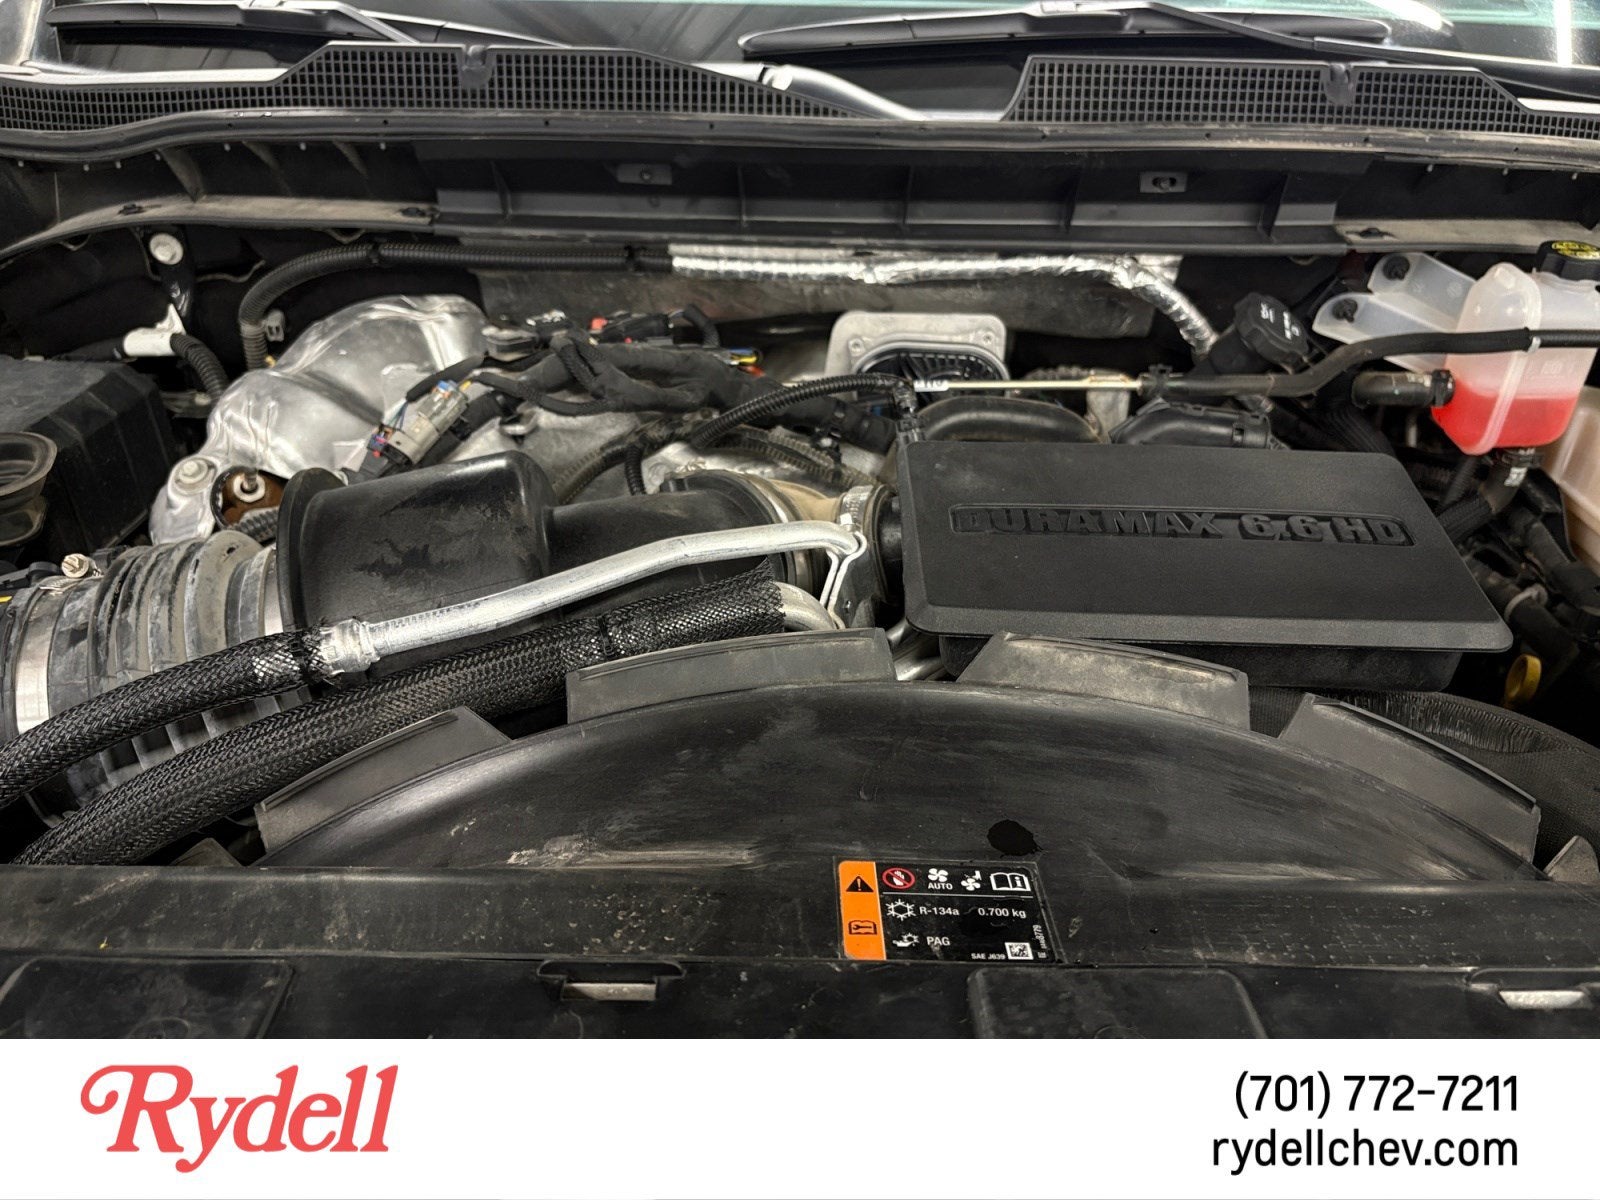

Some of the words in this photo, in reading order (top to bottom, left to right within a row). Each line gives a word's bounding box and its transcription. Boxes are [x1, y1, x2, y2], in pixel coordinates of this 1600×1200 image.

[953, 507, 1222, 538] DURAMAX
[1238, 513, 1324, 541] 6.6
[1335, 516, 1414, 545] HD
[927, 882, 953, 890] AUTO
[919, 906, 960, 916] R-134a
[977, 907, 1010, 917] 0.700
[1011, 908, 1027, 919] kg
[926, 936, 951, 947] PAG
[970, 952, 986, 960] SAE
